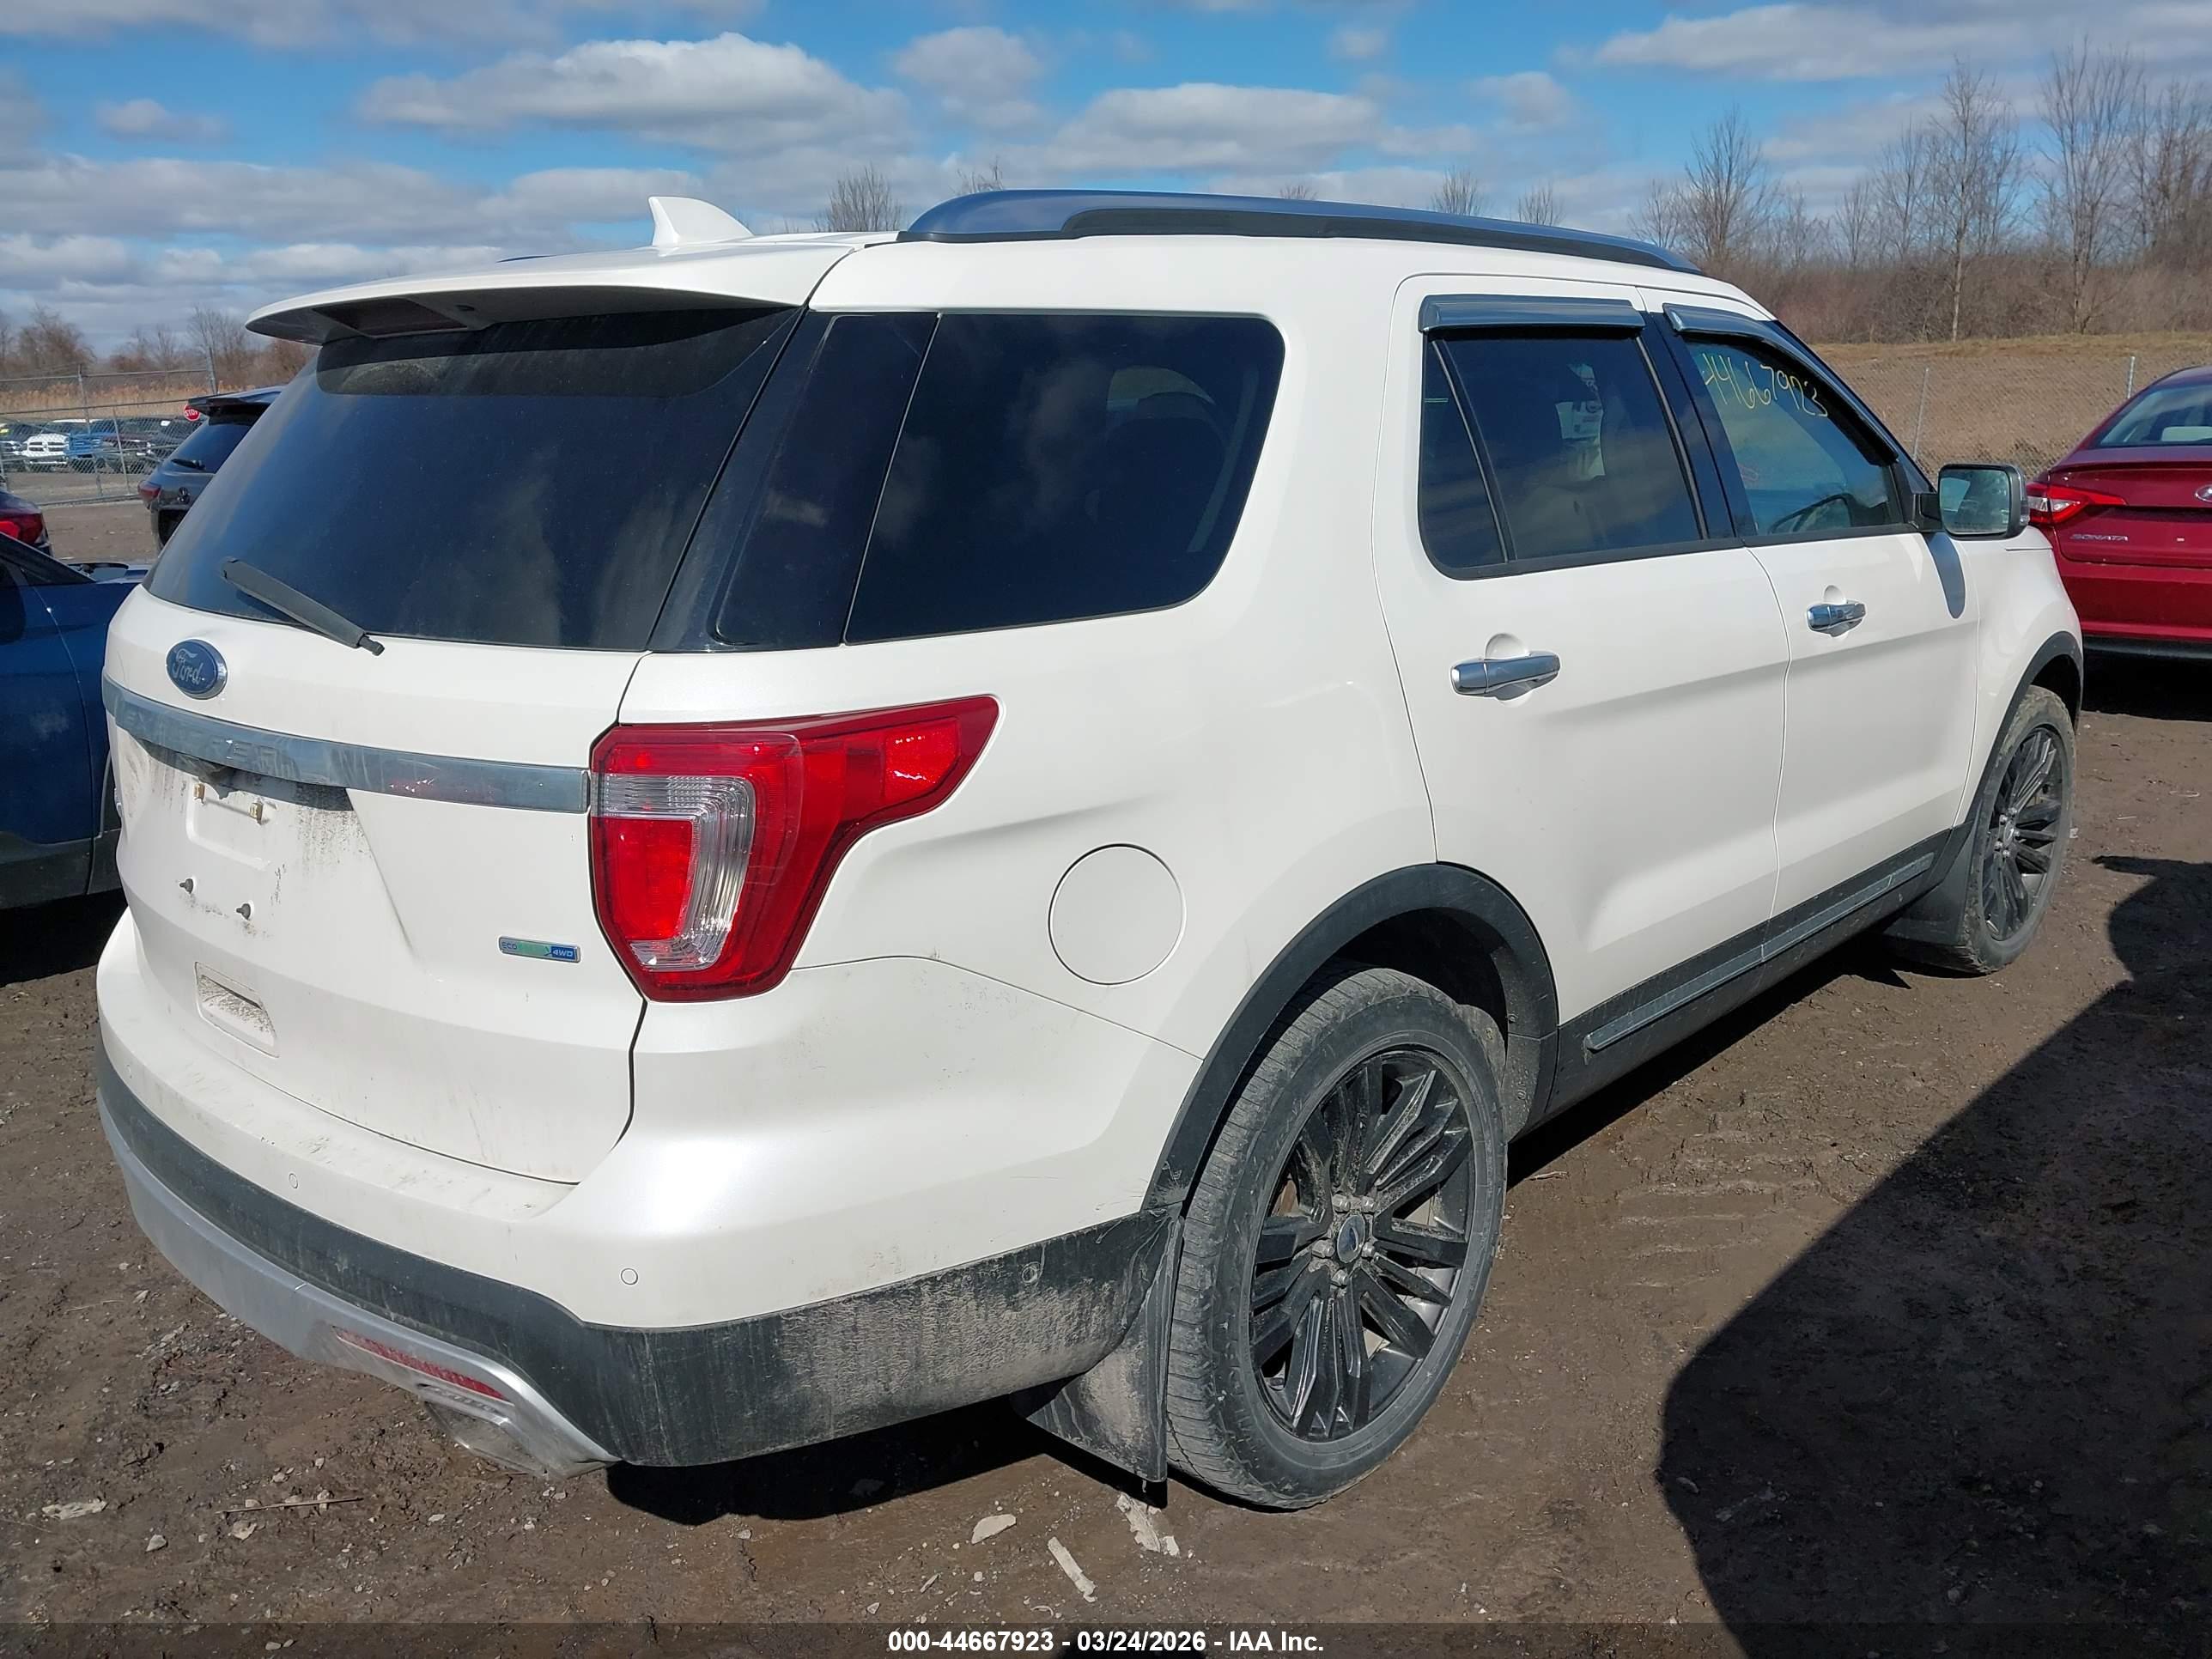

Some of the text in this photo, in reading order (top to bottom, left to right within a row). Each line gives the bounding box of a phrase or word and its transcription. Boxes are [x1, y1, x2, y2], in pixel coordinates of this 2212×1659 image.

[2069, 533, 2129, 542] SONATA
[172, 647, 205, 686] Ford
[552, 948, 574, 957] 4WD
